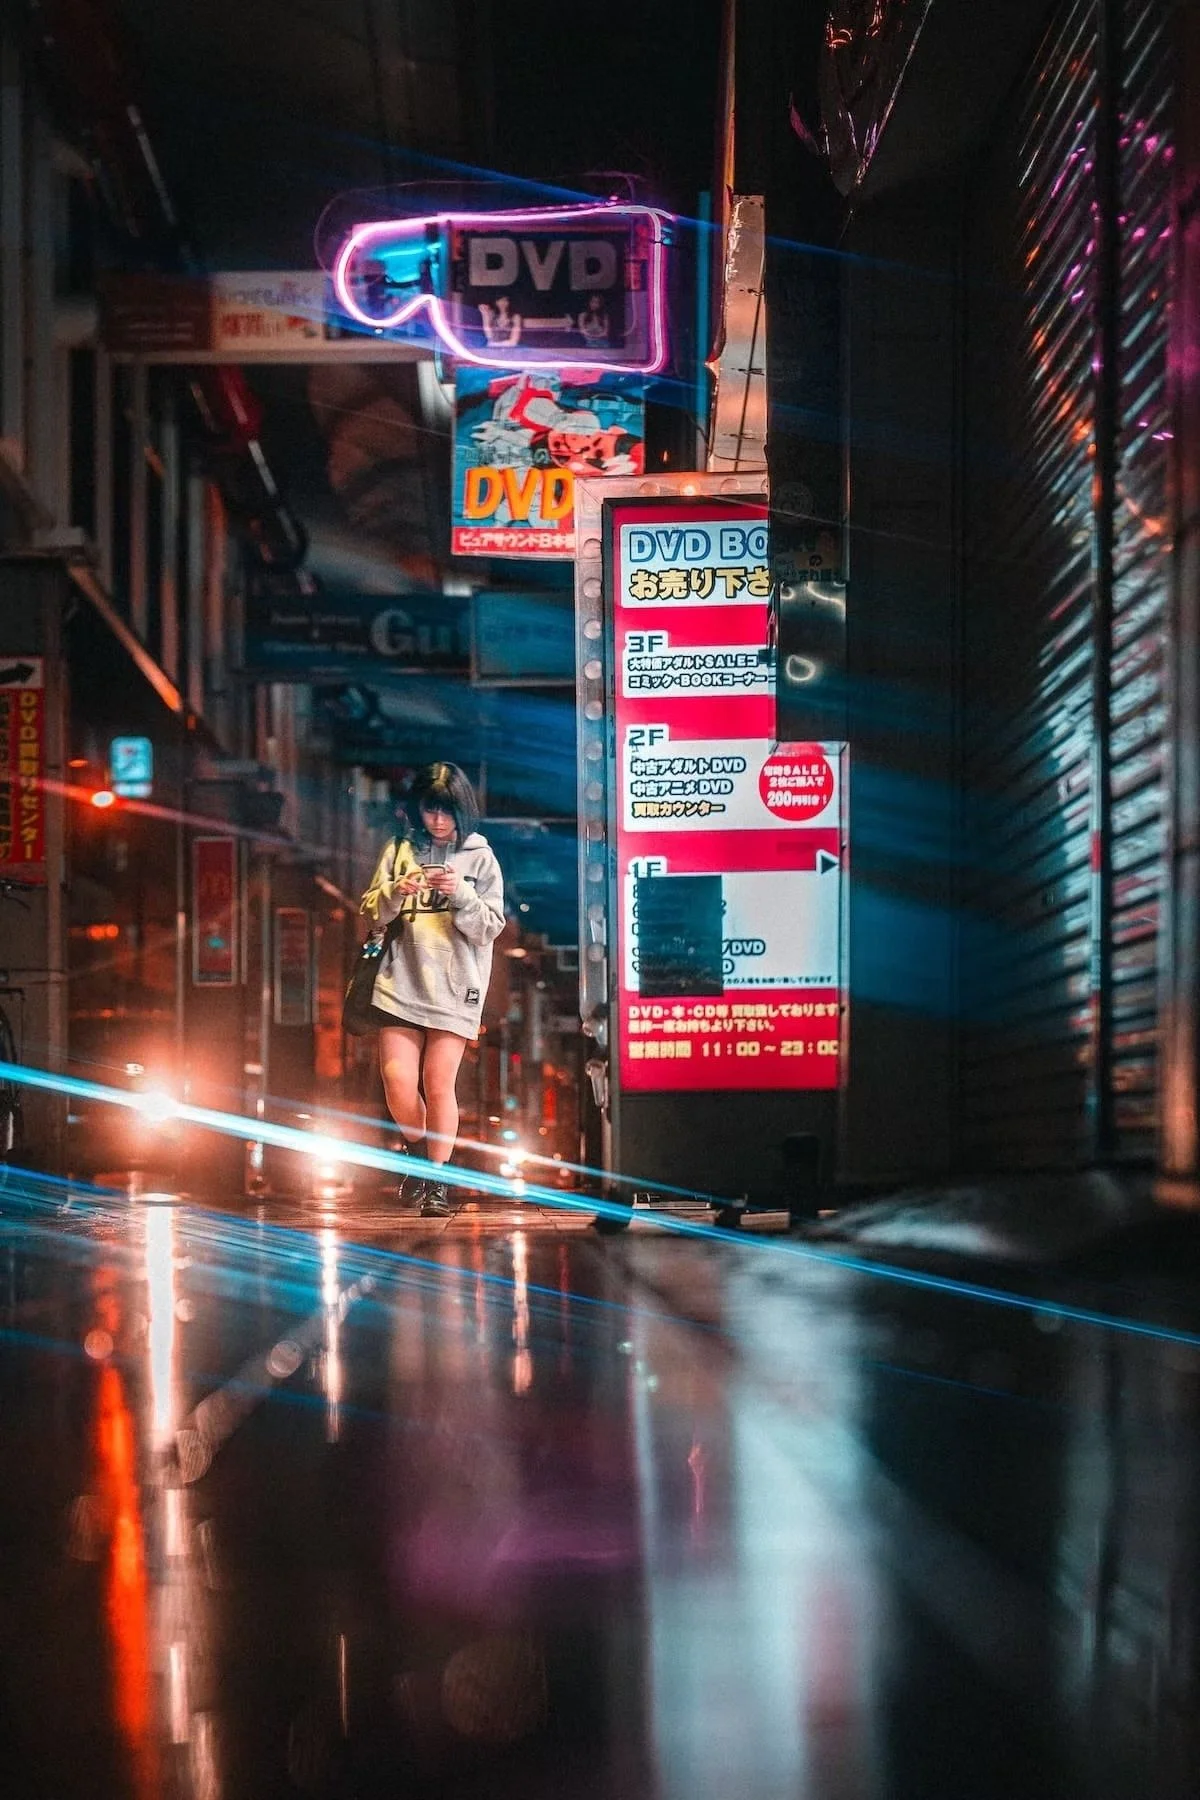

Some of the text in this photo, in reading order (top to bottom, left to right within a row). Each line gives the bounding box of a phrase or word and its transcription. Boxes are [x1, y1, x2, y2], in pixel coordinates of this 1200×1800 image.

[468, 237, 618, 291] DVD
[462, 467, 575, 520] DVD
[629, 528, 712, 563] DVD
[628, 634, 663, 653] 3F
[628, 728, 664, 747] 2F
